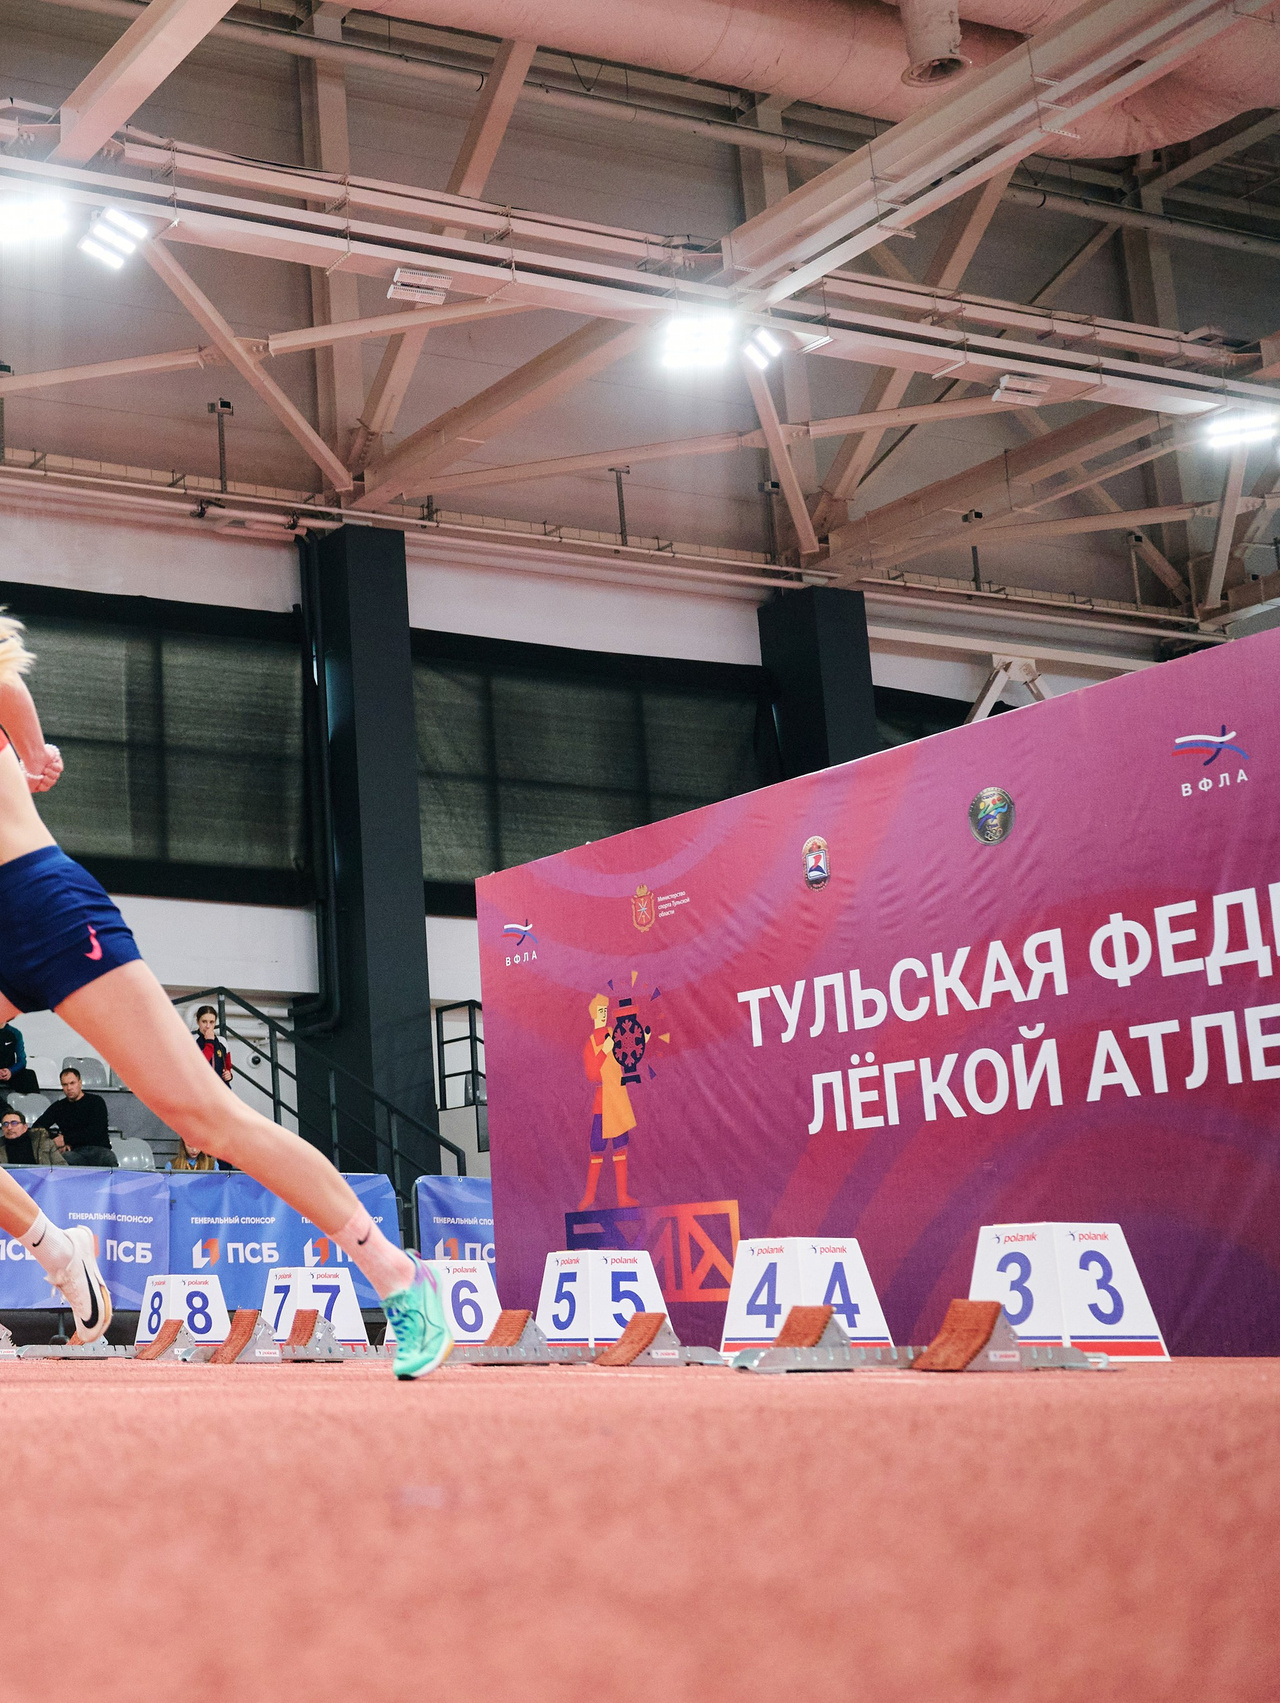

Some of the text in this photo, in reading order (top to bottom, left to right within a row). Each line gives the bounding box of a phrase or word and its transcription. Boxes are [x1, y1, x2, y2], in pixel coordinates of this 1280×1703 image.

[1181, 769, 1248, 797] ВФЛА
[505, 950, 538, 967] ВФЛА
[737, 927, 1069, 1048] ТУЛЬСКАЯ
[808, 1022, 1064, 1136] ЛЁГКОЙ
[68, 1212, 154, 1224] ГЕНЕРАЛЬНЫЙ СПОНСОР
[190, 1215, 276, 1225] ГЕНЕРАЛЬНЫЙ СПОНСОР
[433, 1216, 478, 1225] ГЕНЕРАЛЬНЫЙ
[1003, 1231, 1037, 1244] polanik
[1078, 1231, 1109, 1242] polanik
[106, 1239, 153, 1264] ПСБ
[227, 1242, 279, 1264] ПСБ
[560, 1257, 580, 1266] polanik
[610, 1255, 638, 1265] polanik
[757, 1245, 785, 1256] polanik
[820, 1245, 848, 1255] polanik
[187, 1279, 210, 1287] polanik
[316, 1272, 340, 1280] polanik
[452, 1266, 478, 1275] polanik
[611, 1271, 646, 1329] 5
[746, 1262, 782, 1329] 4
[823, 1261, 861, 1328] 4
[996, 1251, 1034, 1326] 3
[1079, 1250, 1124, 1325] 3
[148, 1290, 163, 1335] 8
[185, 1290, 213, 1335] 8
[273, 1284, 291, 1333] 7
[312, 1284, 341, 1323] 7
[451, 1279, 484, 1333] 6
[552, 1272, 577, 1330] 5
